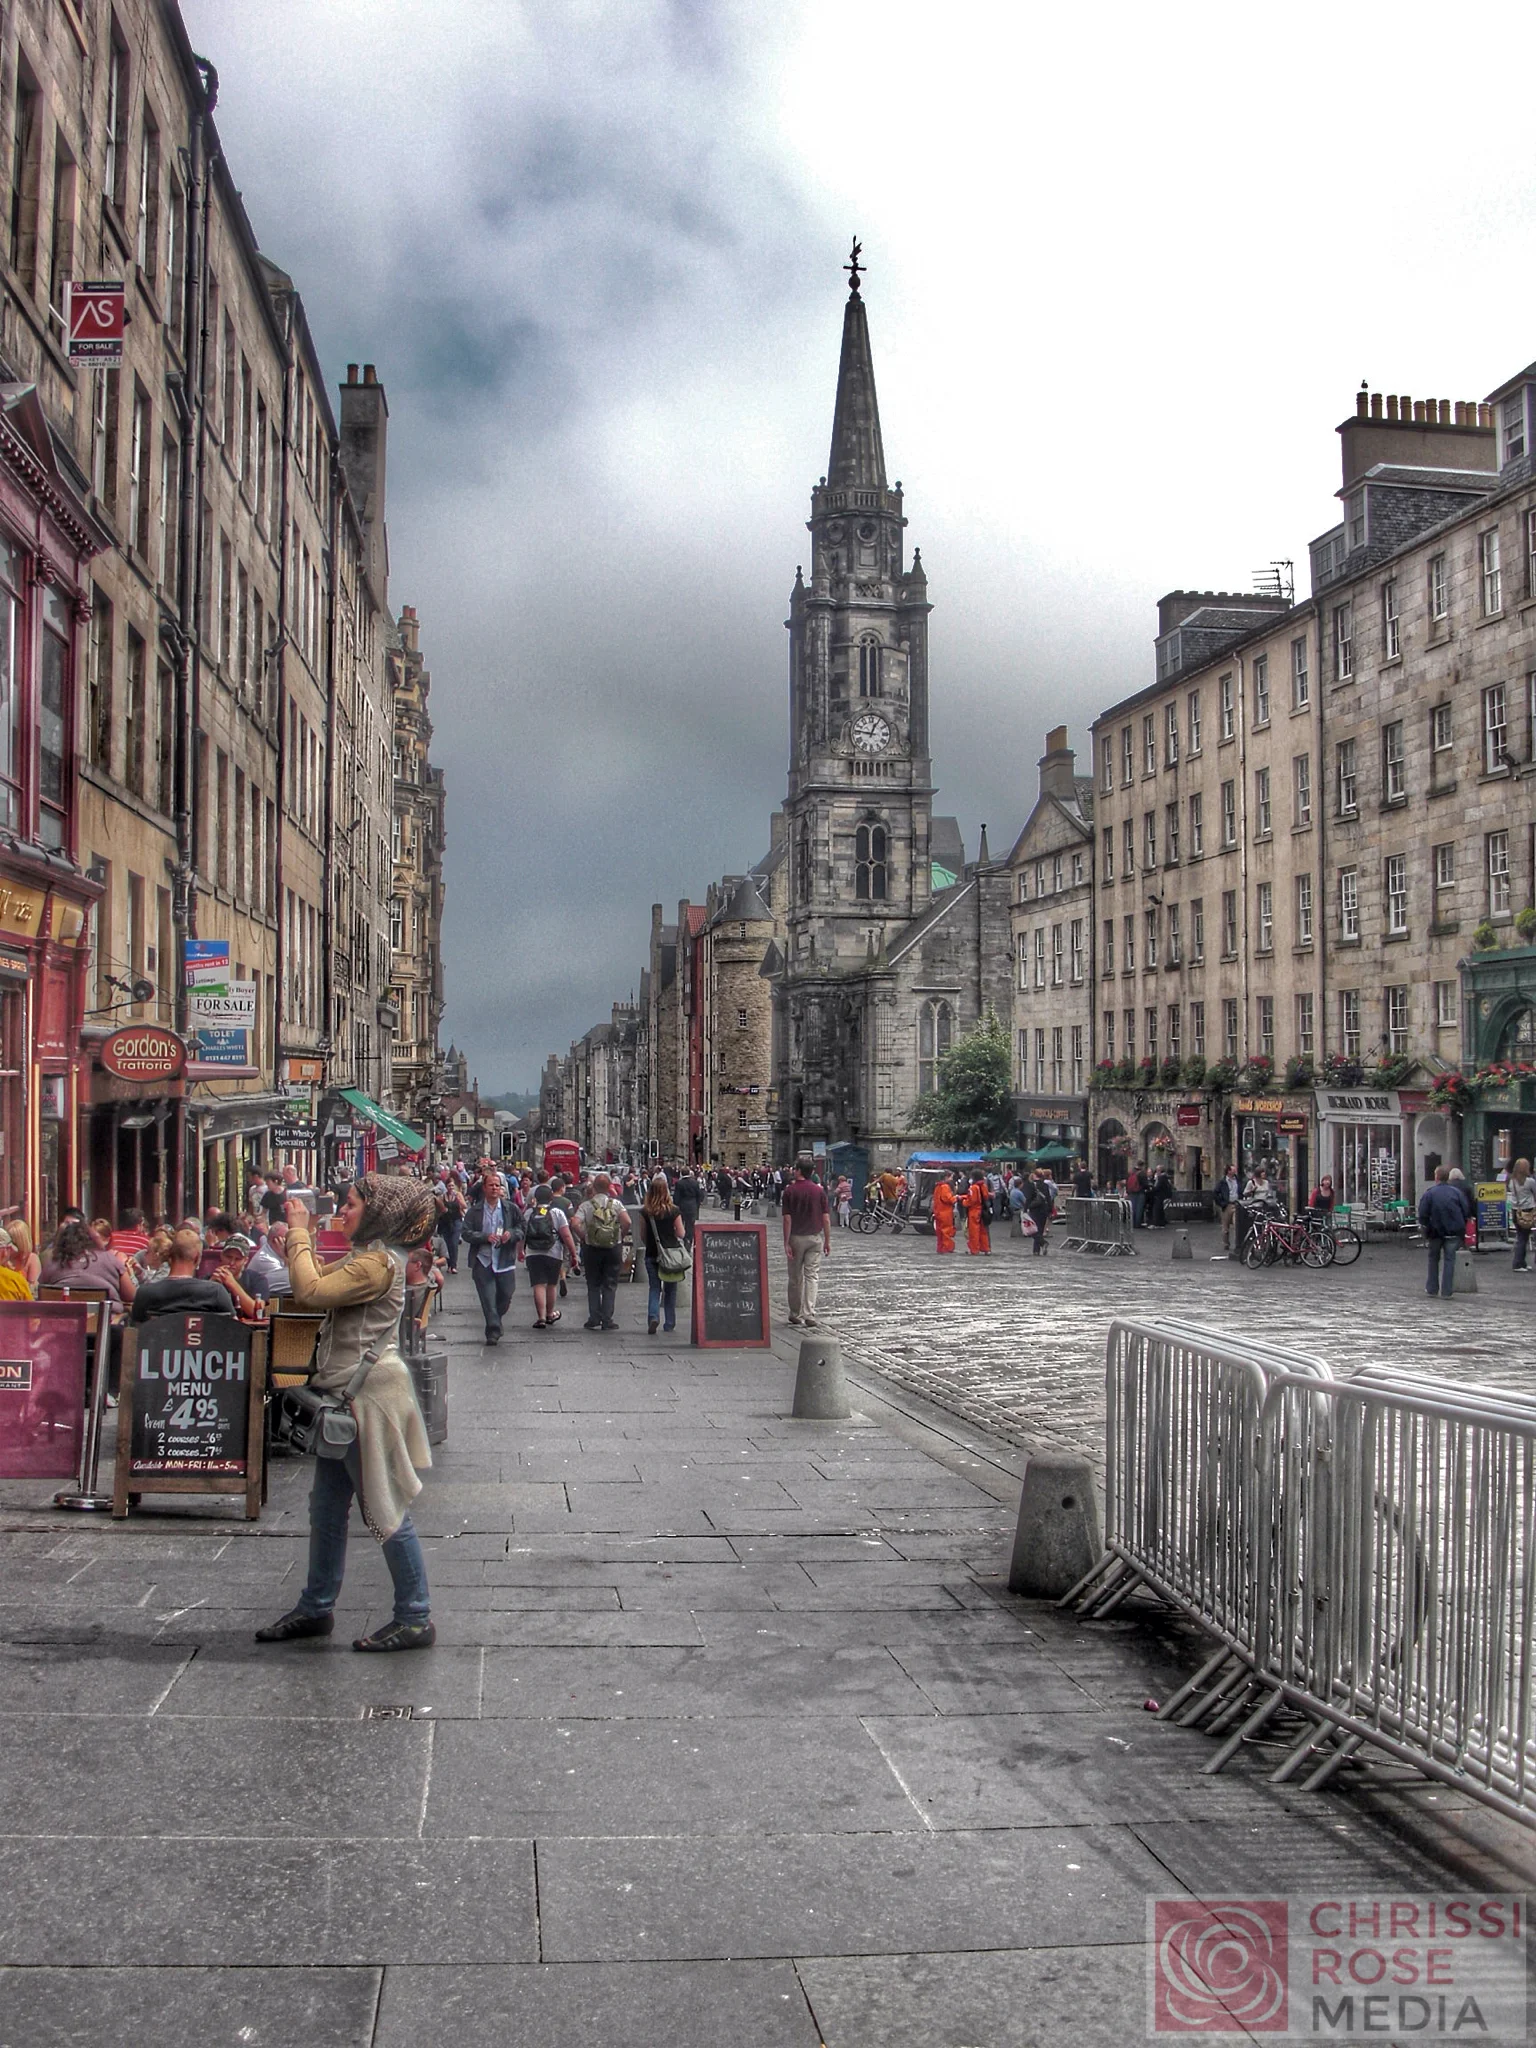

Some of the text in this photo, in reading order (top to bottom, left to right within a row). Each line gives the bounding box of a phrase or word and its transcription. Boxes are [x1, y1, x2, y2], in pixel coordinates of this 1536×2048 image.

[197, 999, 254, 1012] FOR SALE
[112, 1033, 177, 1057] Gordon's
[116, 1061, 172, 1070] Trattoria
[292, 1129, 317, 1139] Whisky
[274, 1136, 308, 1147] Specialist
[140, 1349, 245, 1380] LUNCH
[167, 1382, 212, 1396] MENU
[157, 1432, 165, 1443] 2
[157, 1446, 165, 1456] 3
